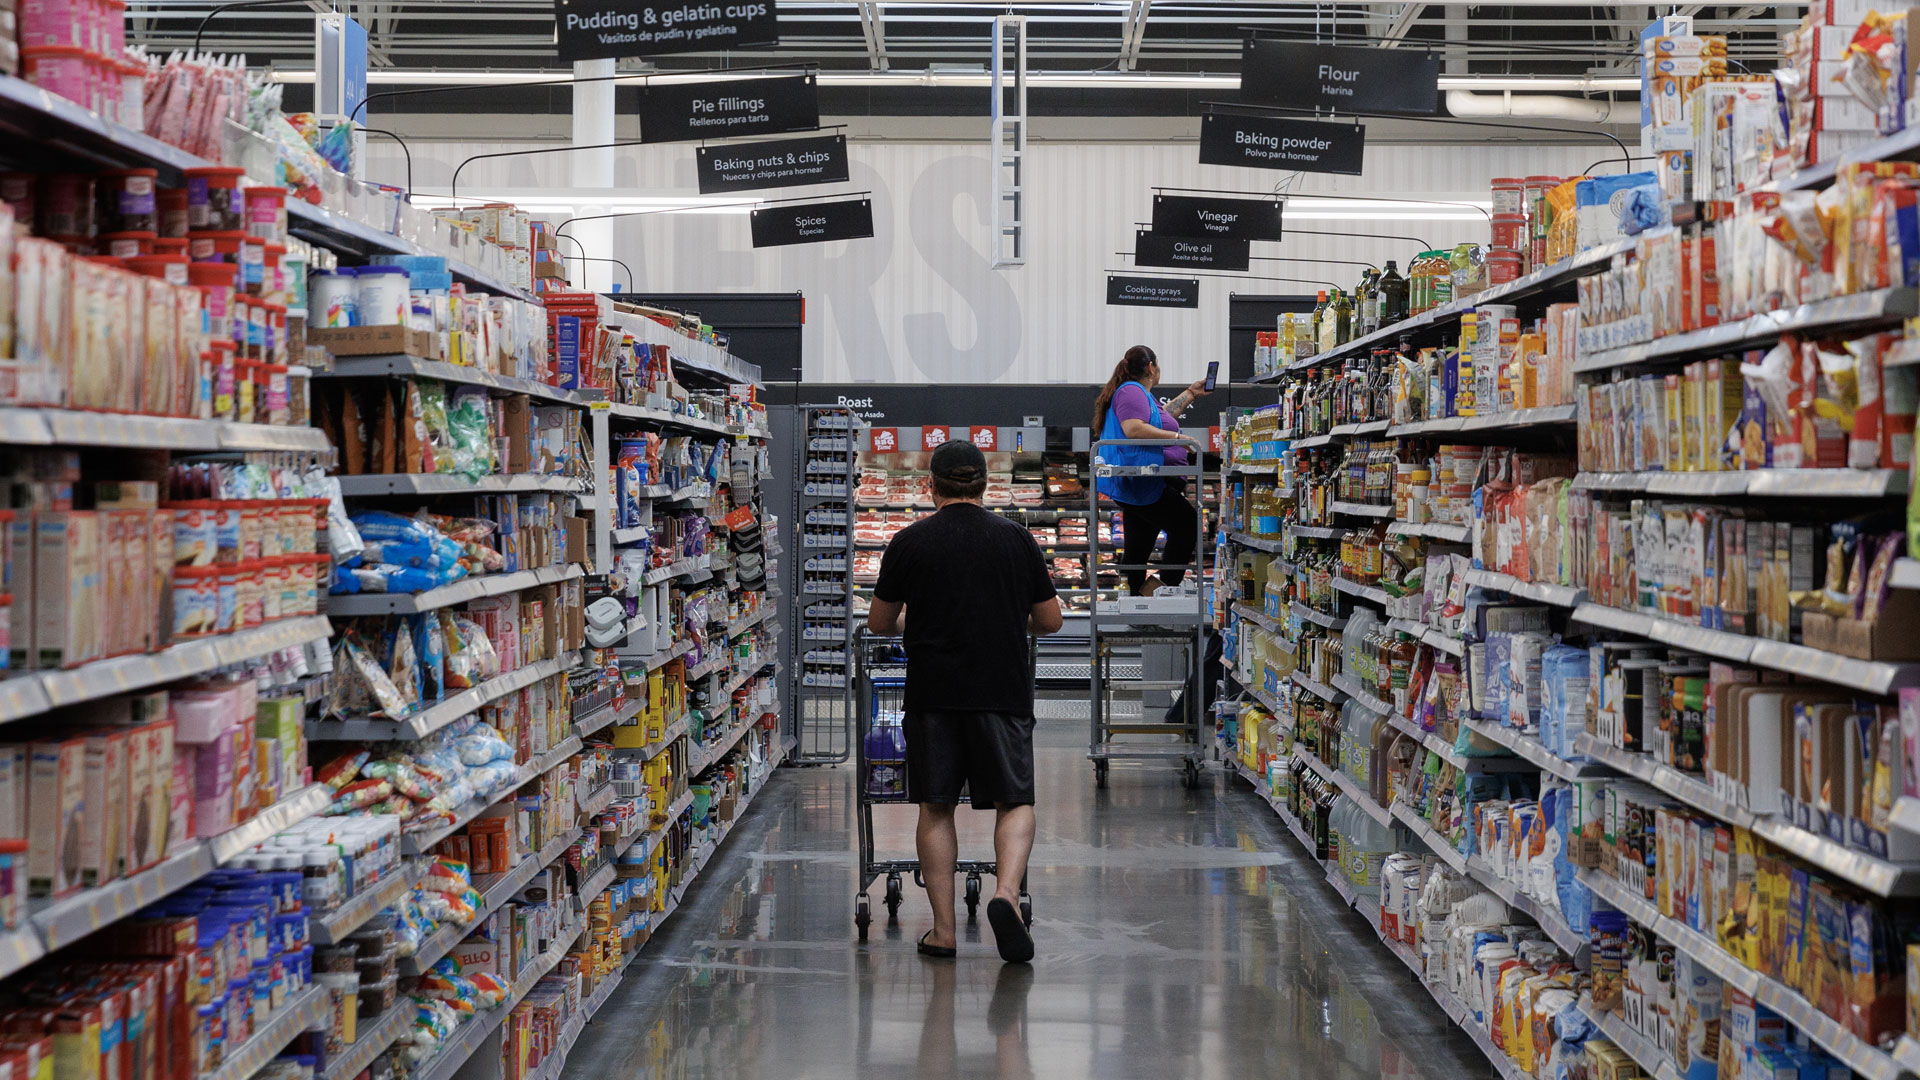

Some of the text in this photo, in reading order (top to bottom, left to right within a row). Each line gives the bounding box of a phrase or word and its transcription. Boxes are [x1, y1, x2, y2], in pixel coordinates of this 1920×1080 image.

[567, 4, 766, 29] Pudding & gelatin cups
[598, 33, 636, 43] Vasitos
[639, 31, 652, 41] de
[686, 30, 693, 39] y
[695, 25, 737, 39] gelatina
[1319, 65, 1359, 81] Flour
[1322, 85, 1353, 96] Harina
[693, 97, 764, 112] Pie fillings
[690, 118, 726, 126] Rellenos
[728, 117, 746, 126] para
[1236, 131, 1331, 150] Baking powder
[715, 151, 829, 170] Baking nuts & chips
[1246, 148, 1267, 157] Polvo
[1288, 152, 1319, 161] hornear
[778, 170, 793, 178] para
[796, 217, 826, 228] Spices
[1198, 210, 1238, 223] Vinegar
[1205, 224, 1229, 232] Vinagre
[1175, 243, 1198, 252] Olive
[1125, 285, 1155, 295] Cooking
[838, 396, 873, 408] Roast
[463, 951, 491, 965] ELL-O
